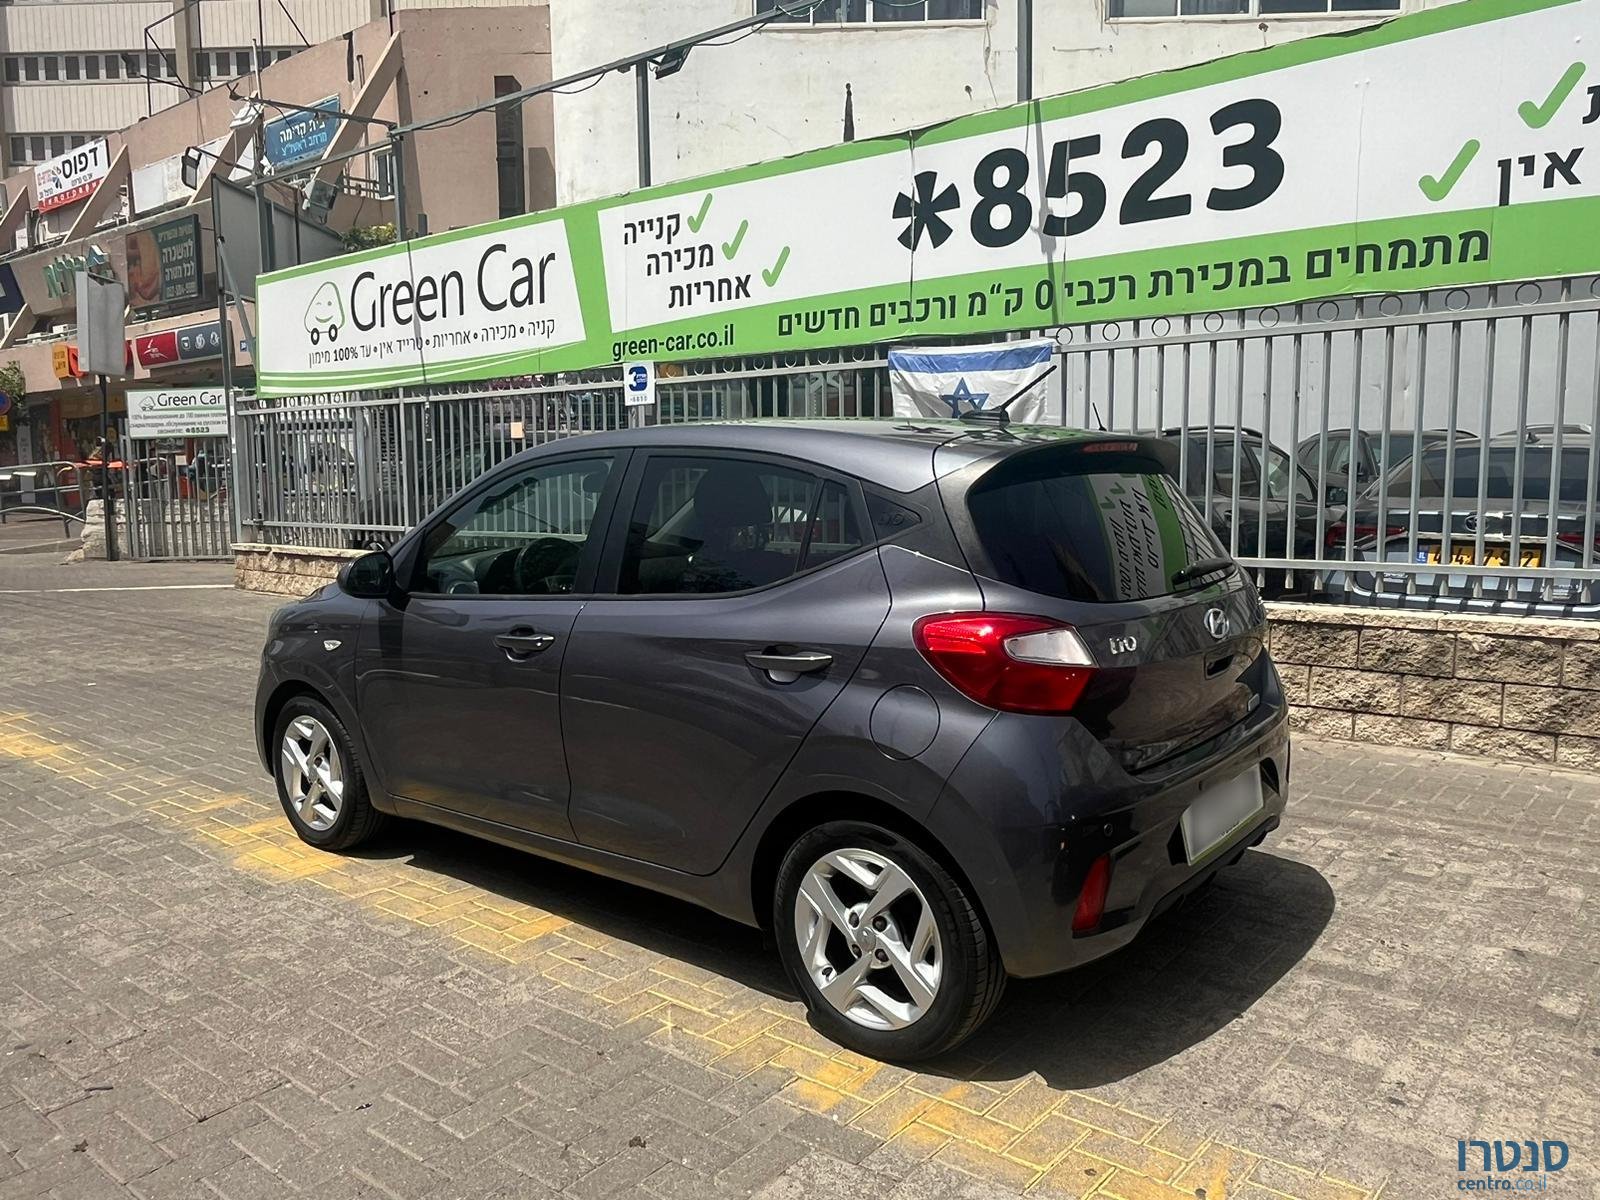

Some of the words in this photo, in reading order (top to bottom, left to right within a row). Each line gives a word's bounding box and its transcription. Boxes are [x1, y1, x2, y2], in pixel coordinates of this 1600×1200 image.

[62, 147, 98, 179] דפוס
[1497, 146, 1585, 207] אין
[623, 213, 681, 245] קנייה
[646, 243, 714, 276] מכירה
[1306, 229, 1489, 280] מתמחים
[350, 269, 465, 332] Green
[477, 243, 556, 312] Car
[668, 274, 752, 309] אחריות
[1064, 274, 1136, 306] רכבי
[1147, 255, 1291, 299] במכירת
[1035, 279, 1053, 310] 0
[778, 306, 860, 337] חדשים
[869, 295, 957, 327] ורכבים
[396, 336, 423, 352] טרייד
[432, 330, 471, 349] אחריות
[481, 323, 517, 342] מכירה
[527, 319, 555, 339] קניה
[612, 323, 734, 362] green-car.co.il
[308, 350, 331, 368] מימון
[333, 347, 358, 362] 100%
[359, 344, 372, 359] עד
[379, 340, 393, 359] אין
[157, 393, 197, 407] Green
[199, 391, 222, 405] Car
